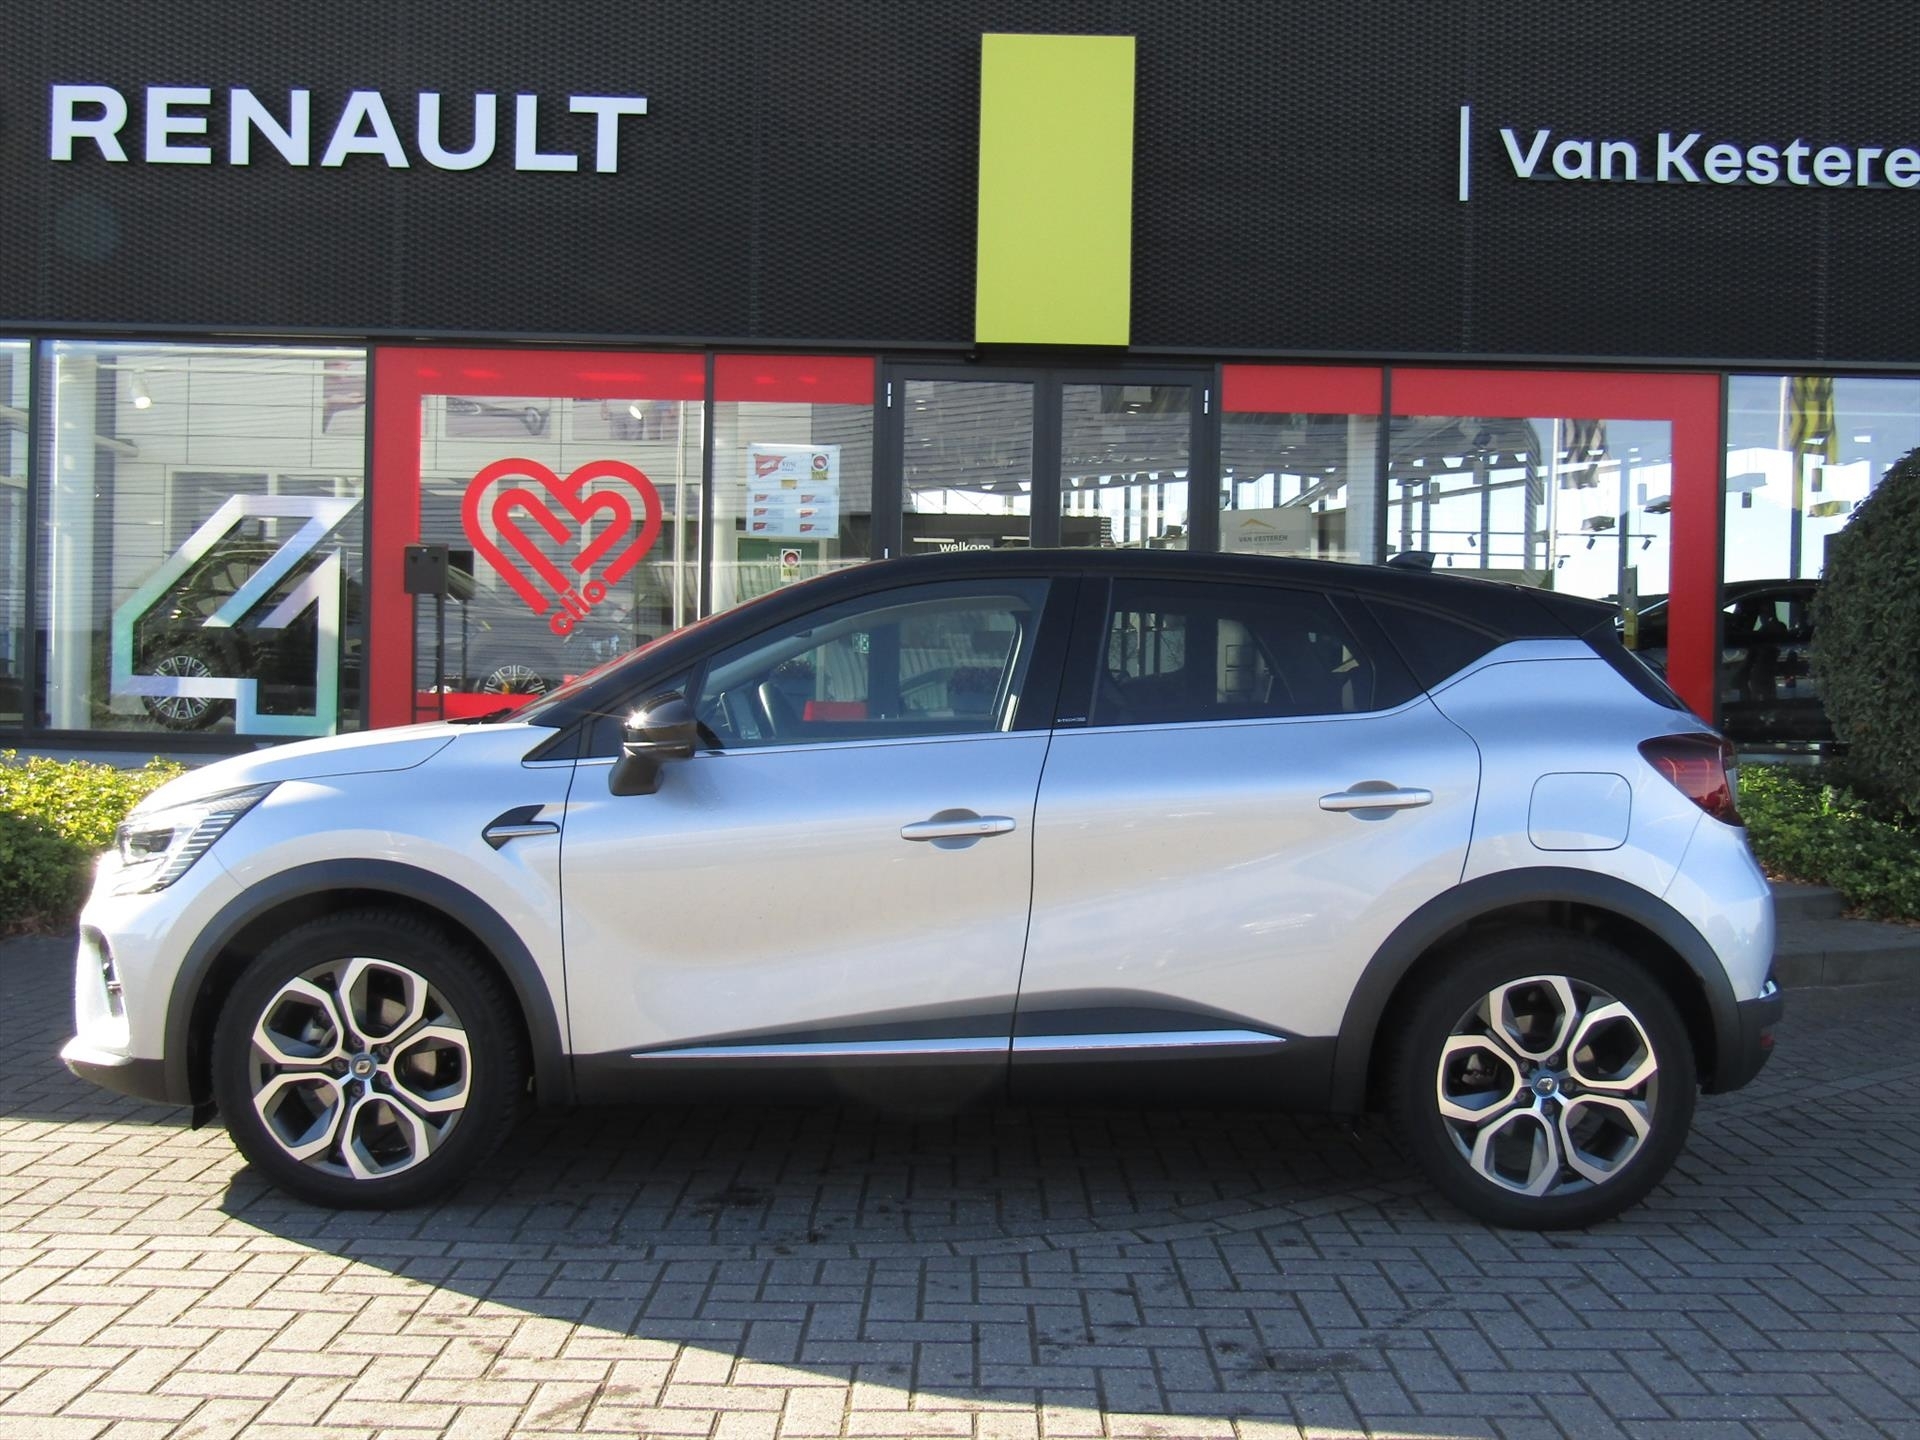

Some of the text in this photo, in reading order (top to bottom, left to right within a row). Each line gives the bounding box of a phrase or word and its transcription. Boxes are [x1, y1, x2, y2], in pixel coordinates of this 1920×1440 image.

[52, 86, 647, 172] RENAULT
[1500, 129, 1920, 187] Van Kestere
[549, 580, 606, 636] clio
